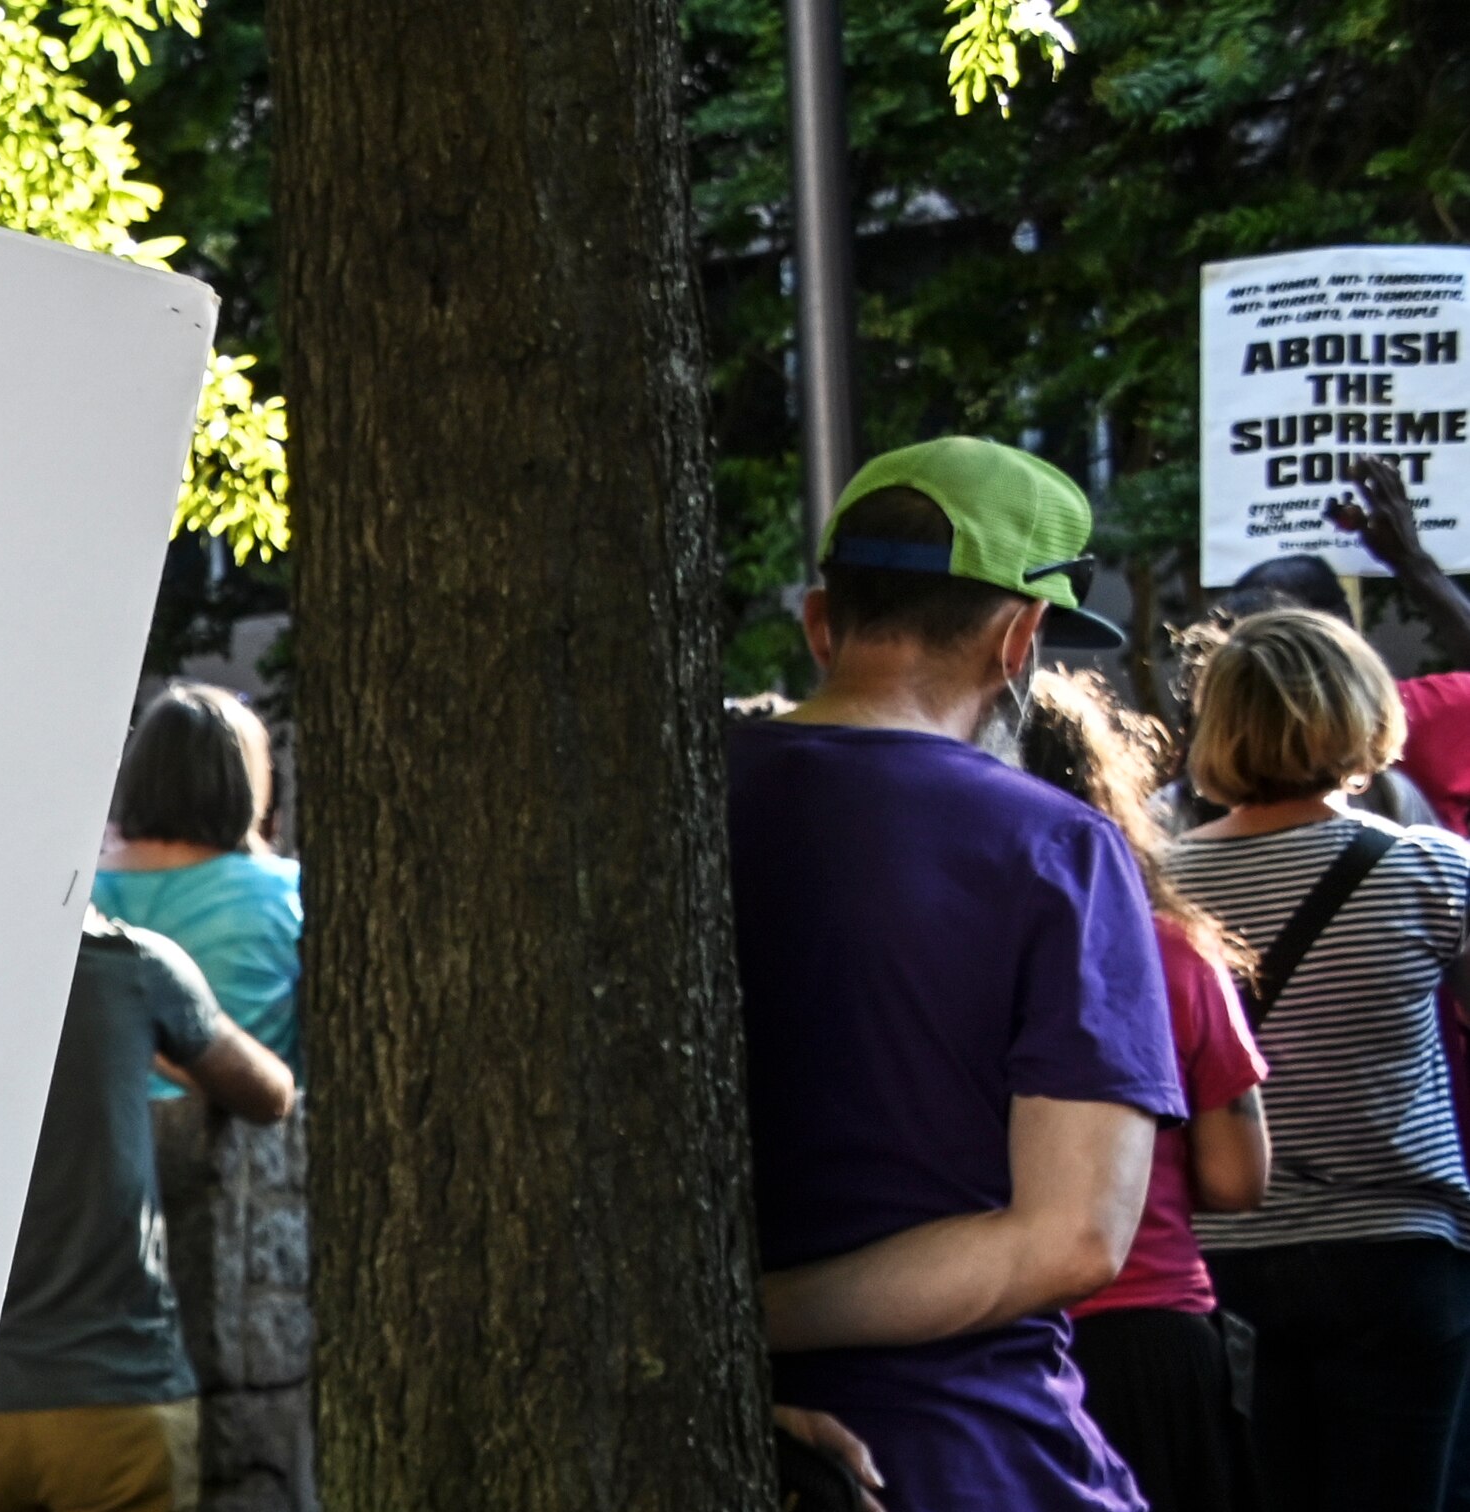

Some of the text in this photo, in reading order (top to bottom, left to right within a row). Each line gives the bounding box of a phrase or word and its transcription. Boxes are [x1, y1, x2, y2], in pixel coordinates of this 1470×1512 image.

[1242, 330, 1458, 374] ABOLISH
[1305, 373, 1394, 406] THE
[1230, 410, 1468, 454] SUPREME
